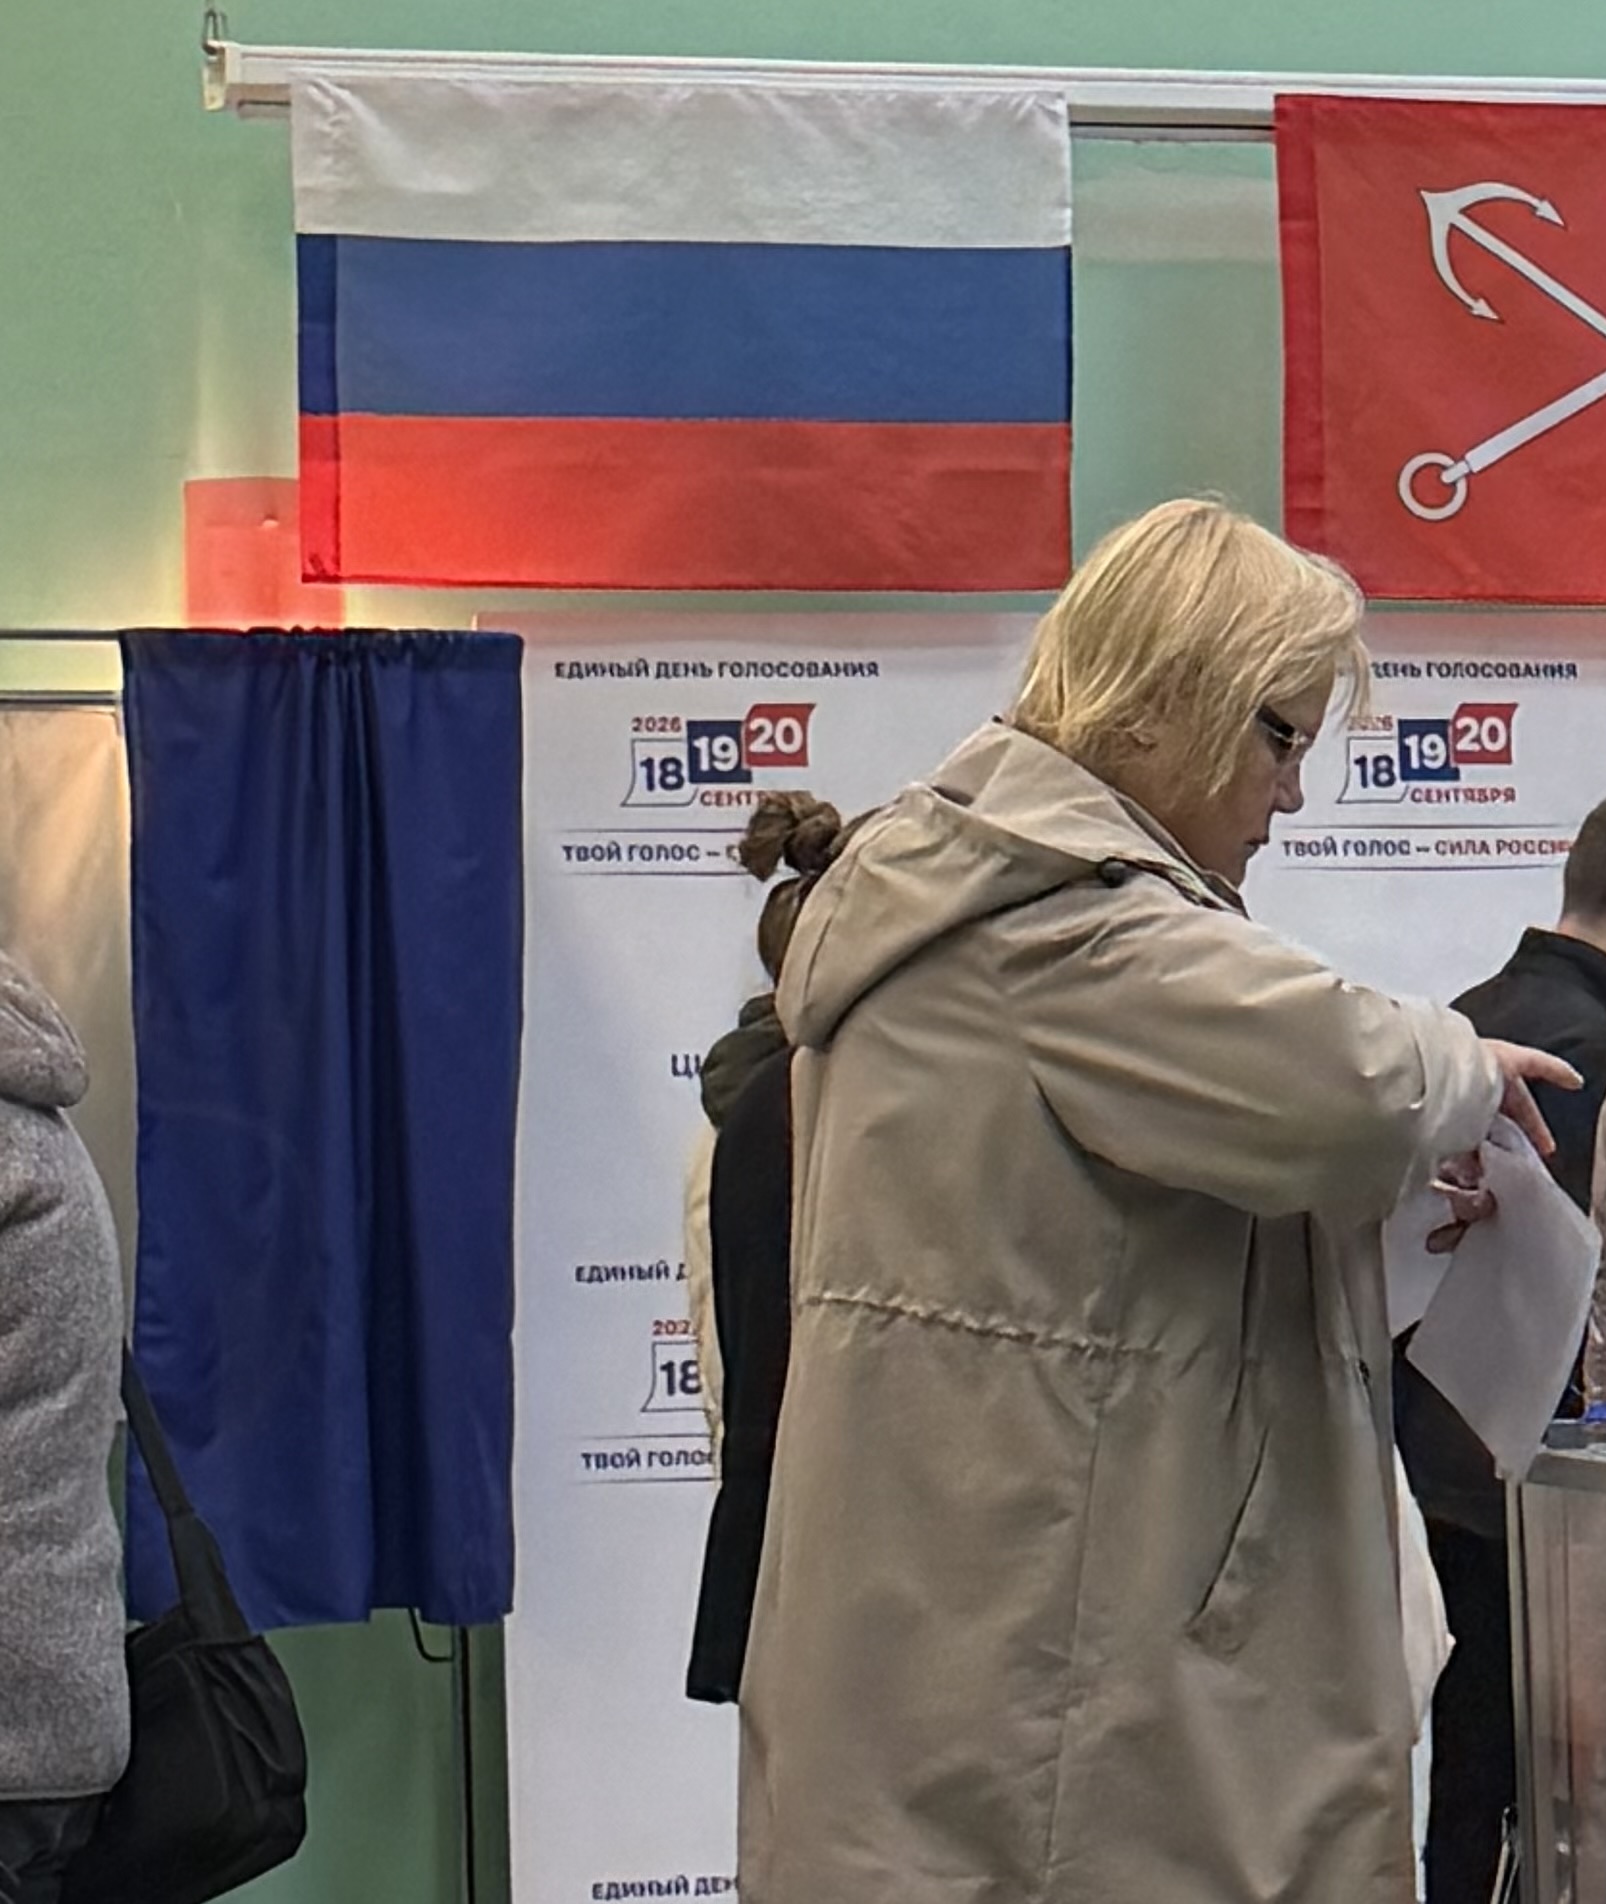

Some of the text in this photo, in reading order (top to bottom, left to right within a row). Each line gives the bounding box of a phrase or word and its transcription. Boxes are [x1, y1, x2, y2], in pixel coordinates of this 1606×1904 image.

[554, 658, 880, 680] ЕДИНЫЙ ДЕНЬ ГОЛОСОВАНИЯ
[1427, 662, 1578, 679] ГОЛОСОВАНИЯ
[632, 716, 682, 733] 2026
[640, 717, 804, 791] 18 19 20
[1354, 716, 1507, 788] 18 19 20
[1410, 787, 1516, 804] СЕНТЯБРЯ
[563, 842, 622, 862] ТВОЙ
[628, 845, 700, 862] ГОЛОС
[1282, 836, 1337, 856] ТВОЙ
[1343, 839, 1411, 856] ГОЛОС
[1434, 839, 1491, 856] СИЛА
[575, 1259, 670, 1283] ЕДИНЫЙ
[652, 1319, 698, 1336] 202
[660, 1360, 703, 1396] 18
[580, 1448, 641, 1469] ТВОЙ
[592, 1875, 690, 1901] ЕДИНЫЙ
